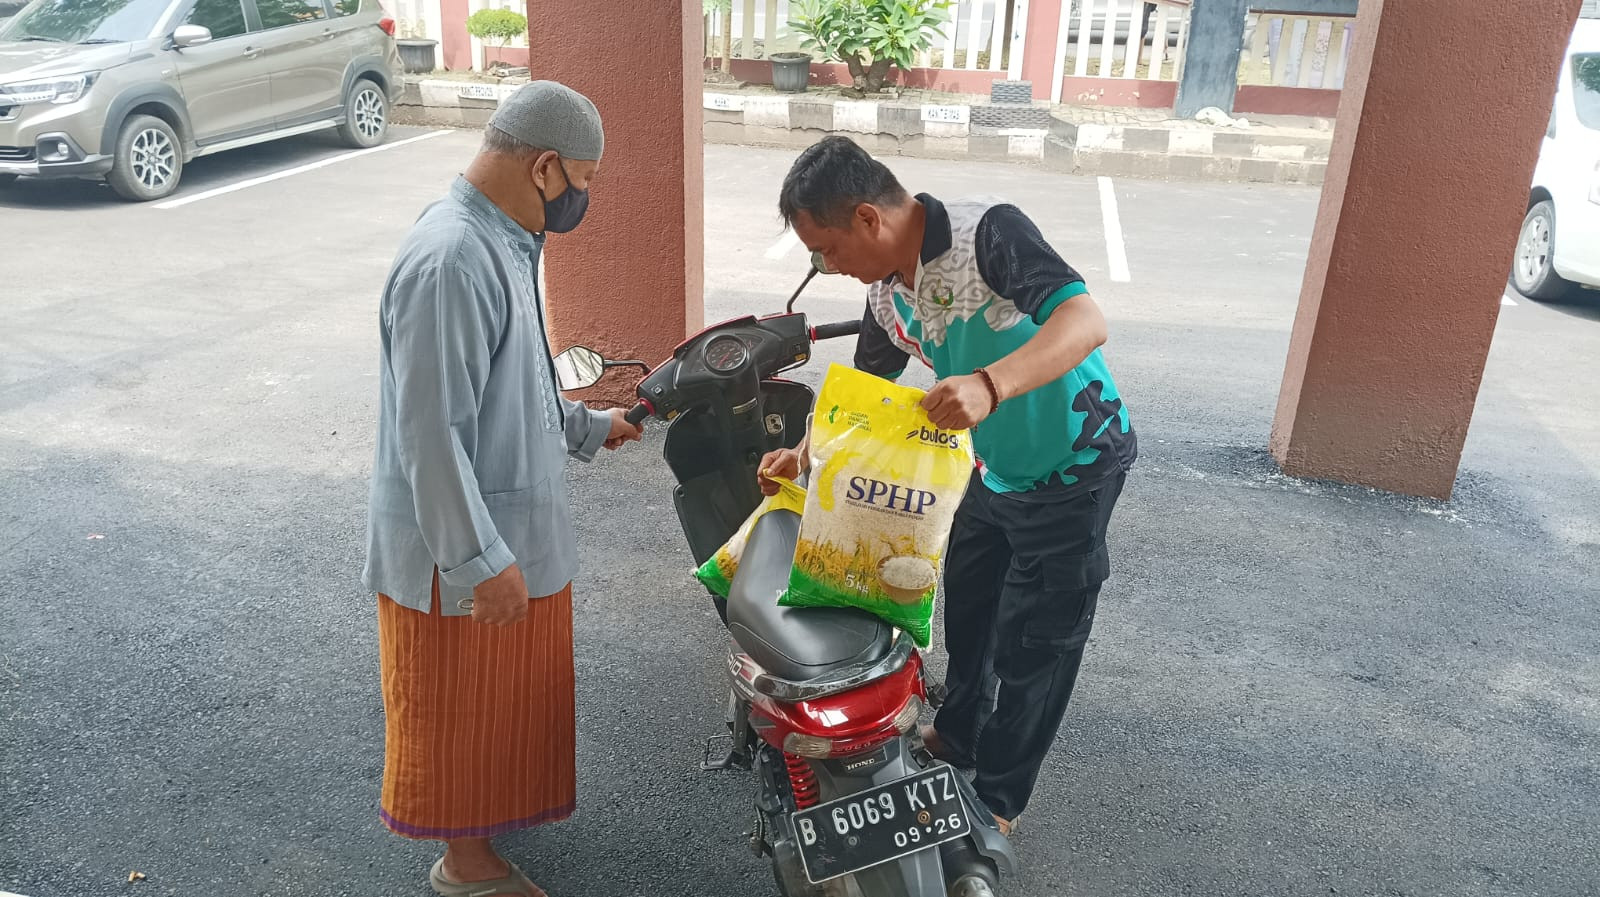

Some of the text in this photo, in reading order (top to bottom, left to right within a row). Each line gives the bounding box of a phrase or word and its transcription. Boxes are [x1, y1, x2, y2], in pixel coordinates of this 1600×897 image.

[920, 426, 958, 449] bulog
[846, 476, 936, 515] SPHP
[799, 772, 955, 846] B 6069 KTZ
